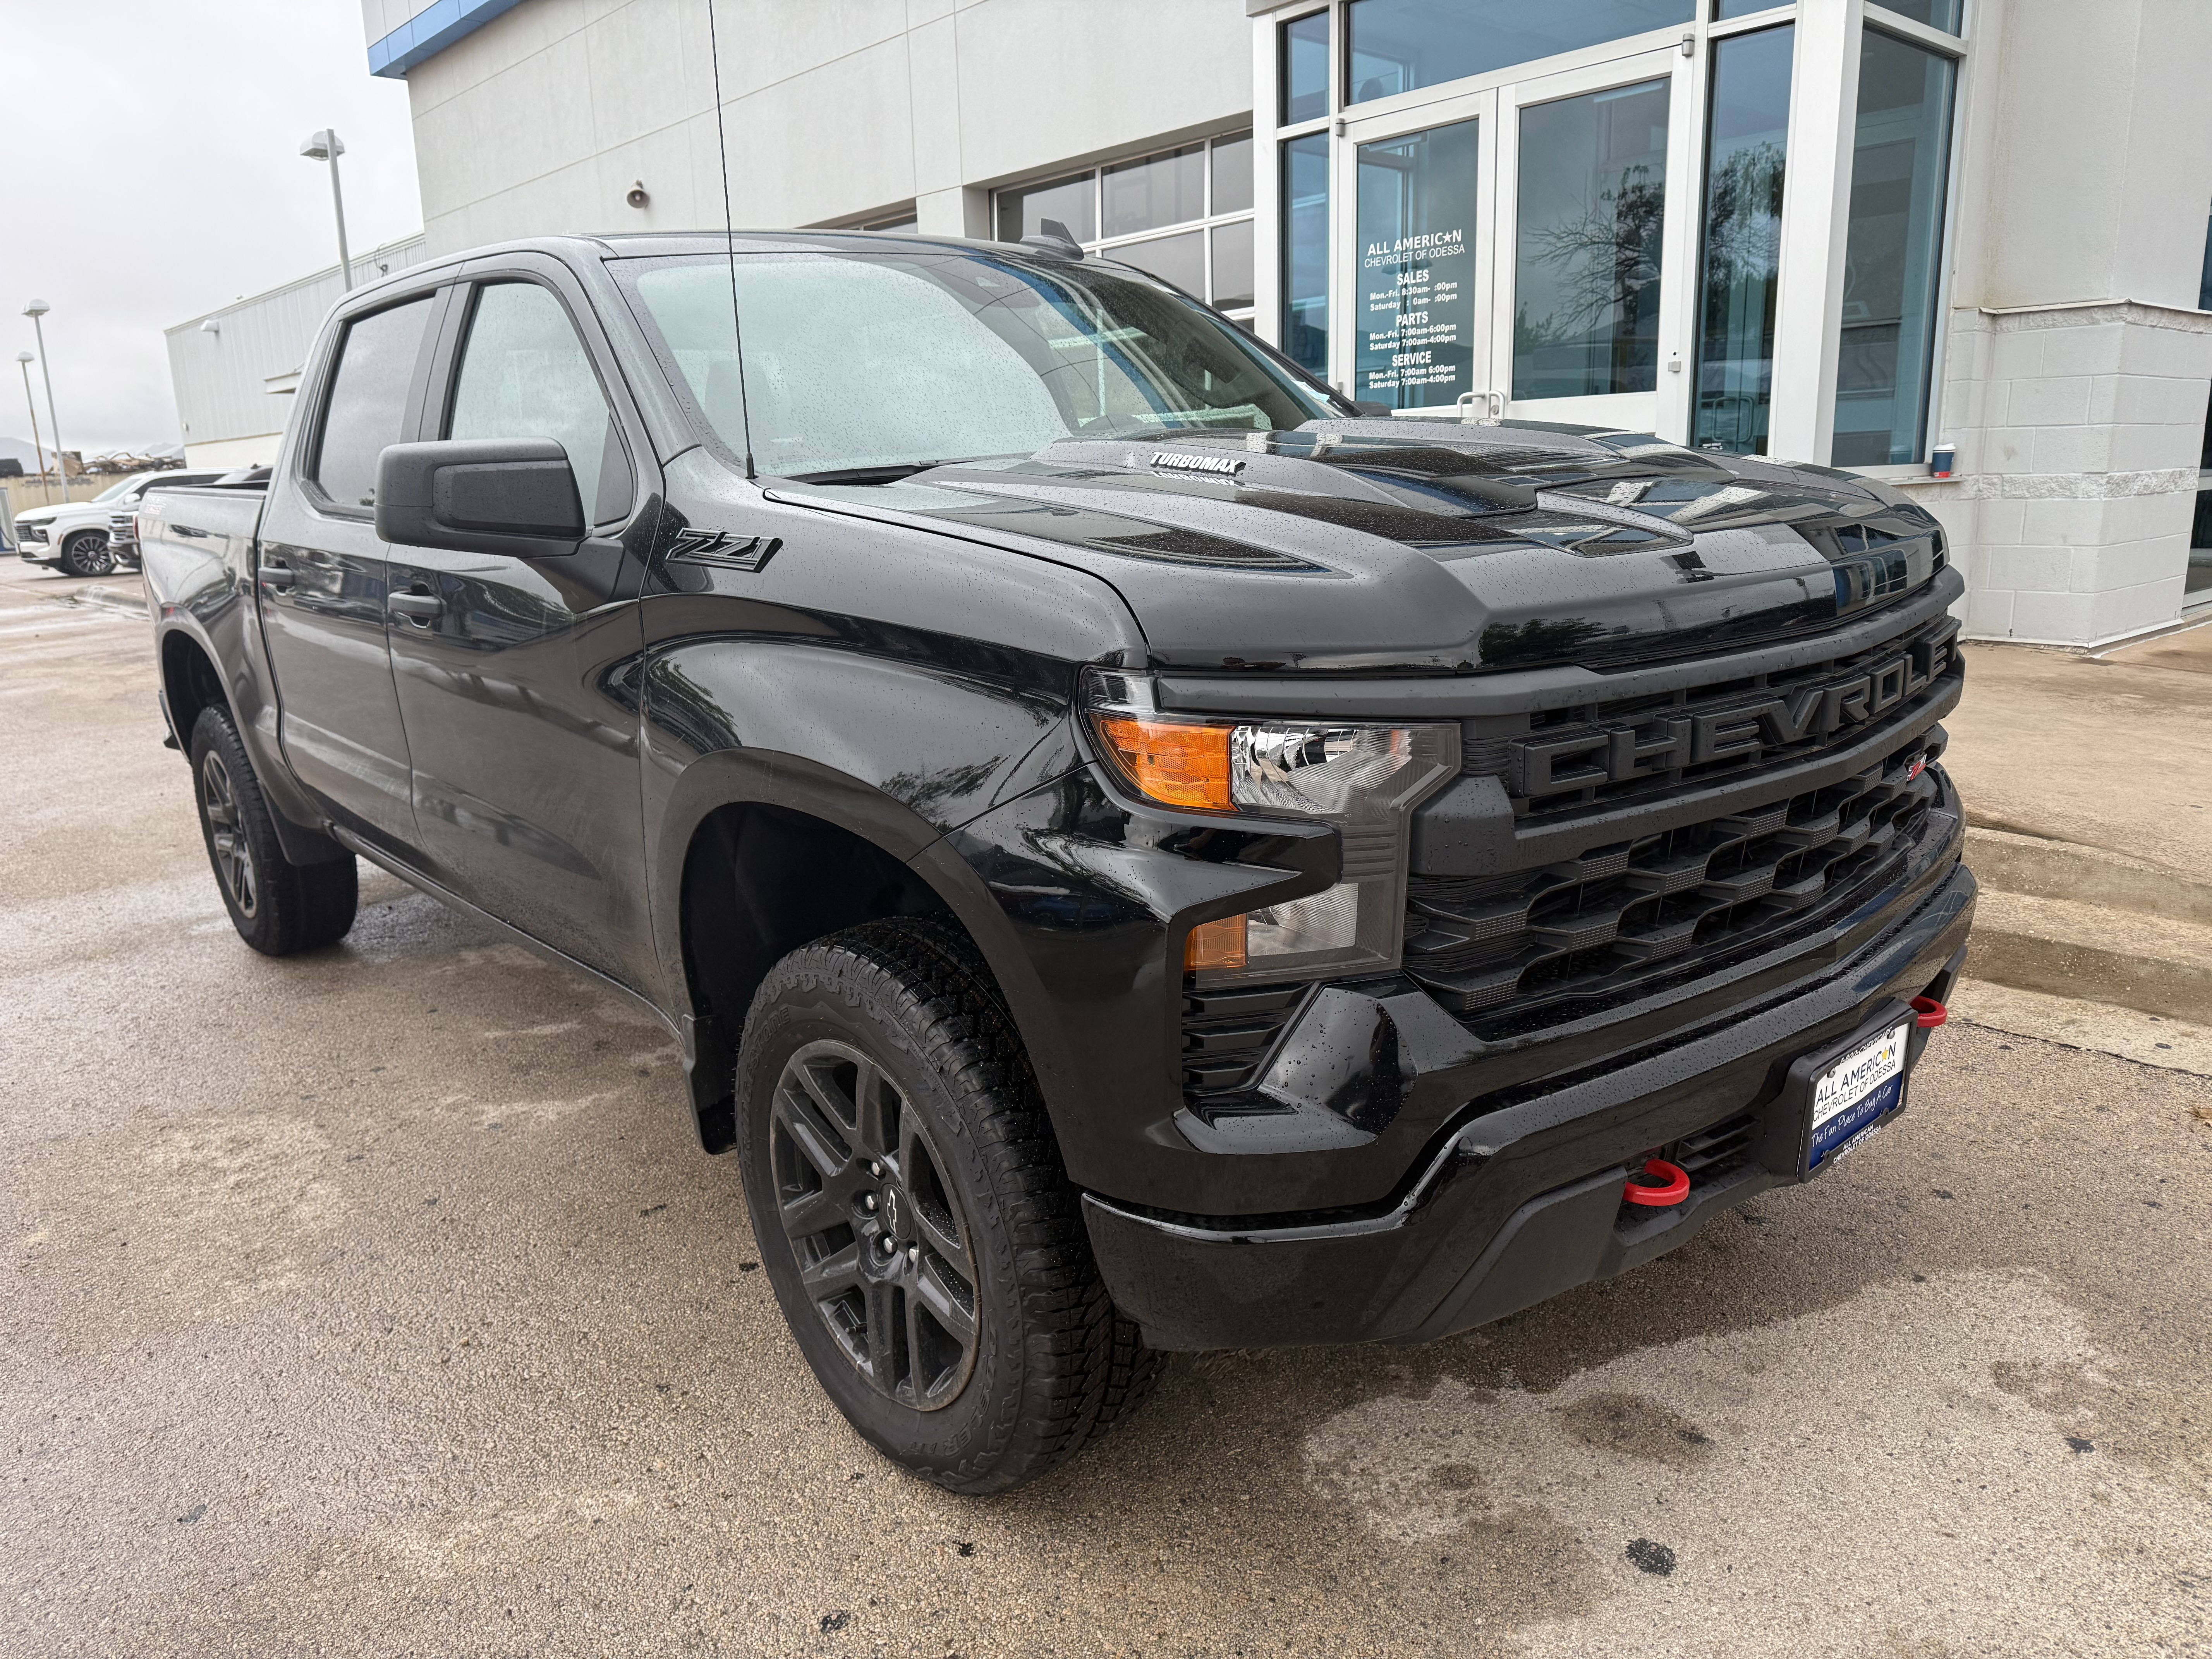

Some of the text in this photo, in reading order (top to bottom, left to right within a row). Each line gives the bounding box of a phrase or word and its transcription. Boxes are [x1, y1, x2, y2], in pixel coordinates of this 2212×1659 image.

[1365, 244, 1465, 268] CHEVROLET OF ODESSA
[1367, 241, 1390, 256] ALL
[1397, 269, 1429, 285] SALES
[1370, 289, 1400, 300] Mon.-Fri.
[1370, 301, 1401, 311] Saturday
[1396, 311, 1428, 327] PARTS
[1369, 324, 1456, 340] Mon.-Fri. 7:00am-6:00pm
[1370, 334, 1456, 350] Saturday 7:00am-4:00pm
[1392, 350, 1432, 367] SERVICE
[1369, 370, 1398, 380] Mon.-Fri.
[1369, 374, 1455, 389] Saturday 7:00am-4:00pm
[1149, 452, 1244, 475] TURBOMAX
[666, 527, 783, 573] Z71
[1509, 618, 1962, 798] CHEVROLE
[1813, 1059, 1896, 1122] CHEVROLET OF ODESSA
[1816, 1081, 1837, 1107] ALL
[1812, 1085, 1893, 1147] The Fun Place To Buy A Car
[1852, 1124, 1874, 1144] AMERICAN
[1833, 1125, 1881, 1164] CHEVROLET OF ODESSA
